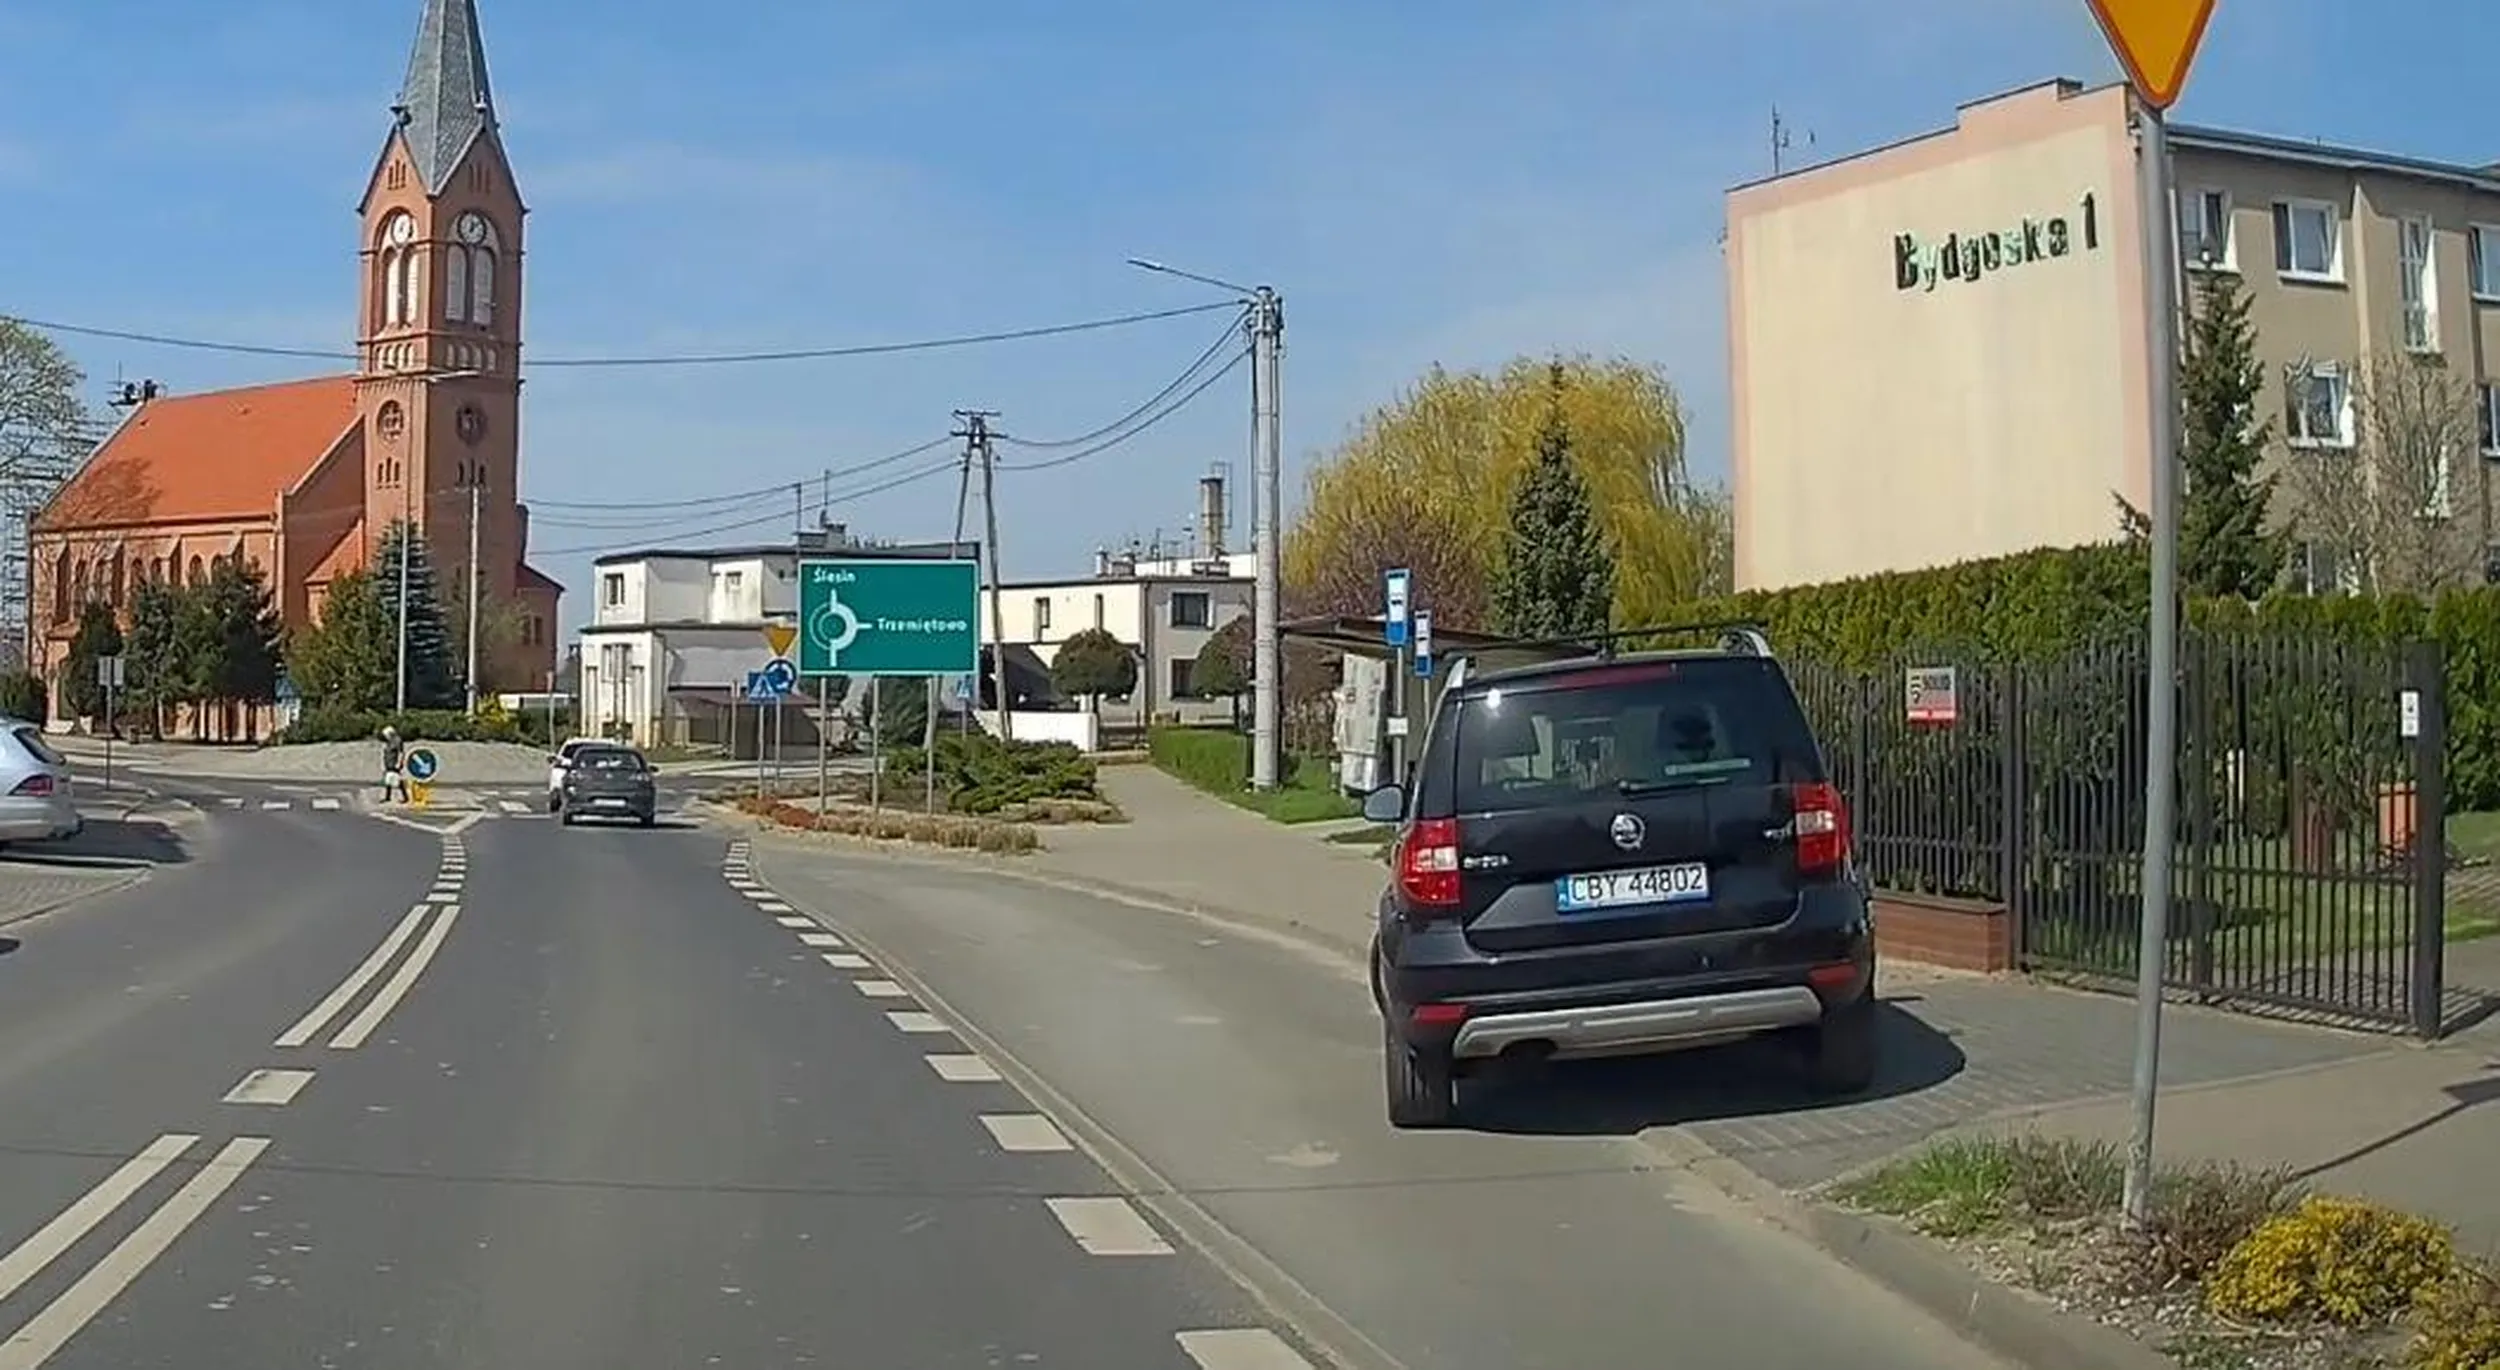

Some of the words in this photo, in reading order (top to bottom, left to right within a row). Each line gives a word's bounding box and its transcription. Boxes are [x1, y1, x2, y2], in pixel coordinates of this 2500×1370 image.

[1894, 217, 2069, 292] Bydgoska
[2080, 192, 2098, 250] 1
[877, 617, 968, 634] Trzemiętowo
[1572, 874, 1618, 901] CBY
[1629, 866, 1703, 895] 44802
